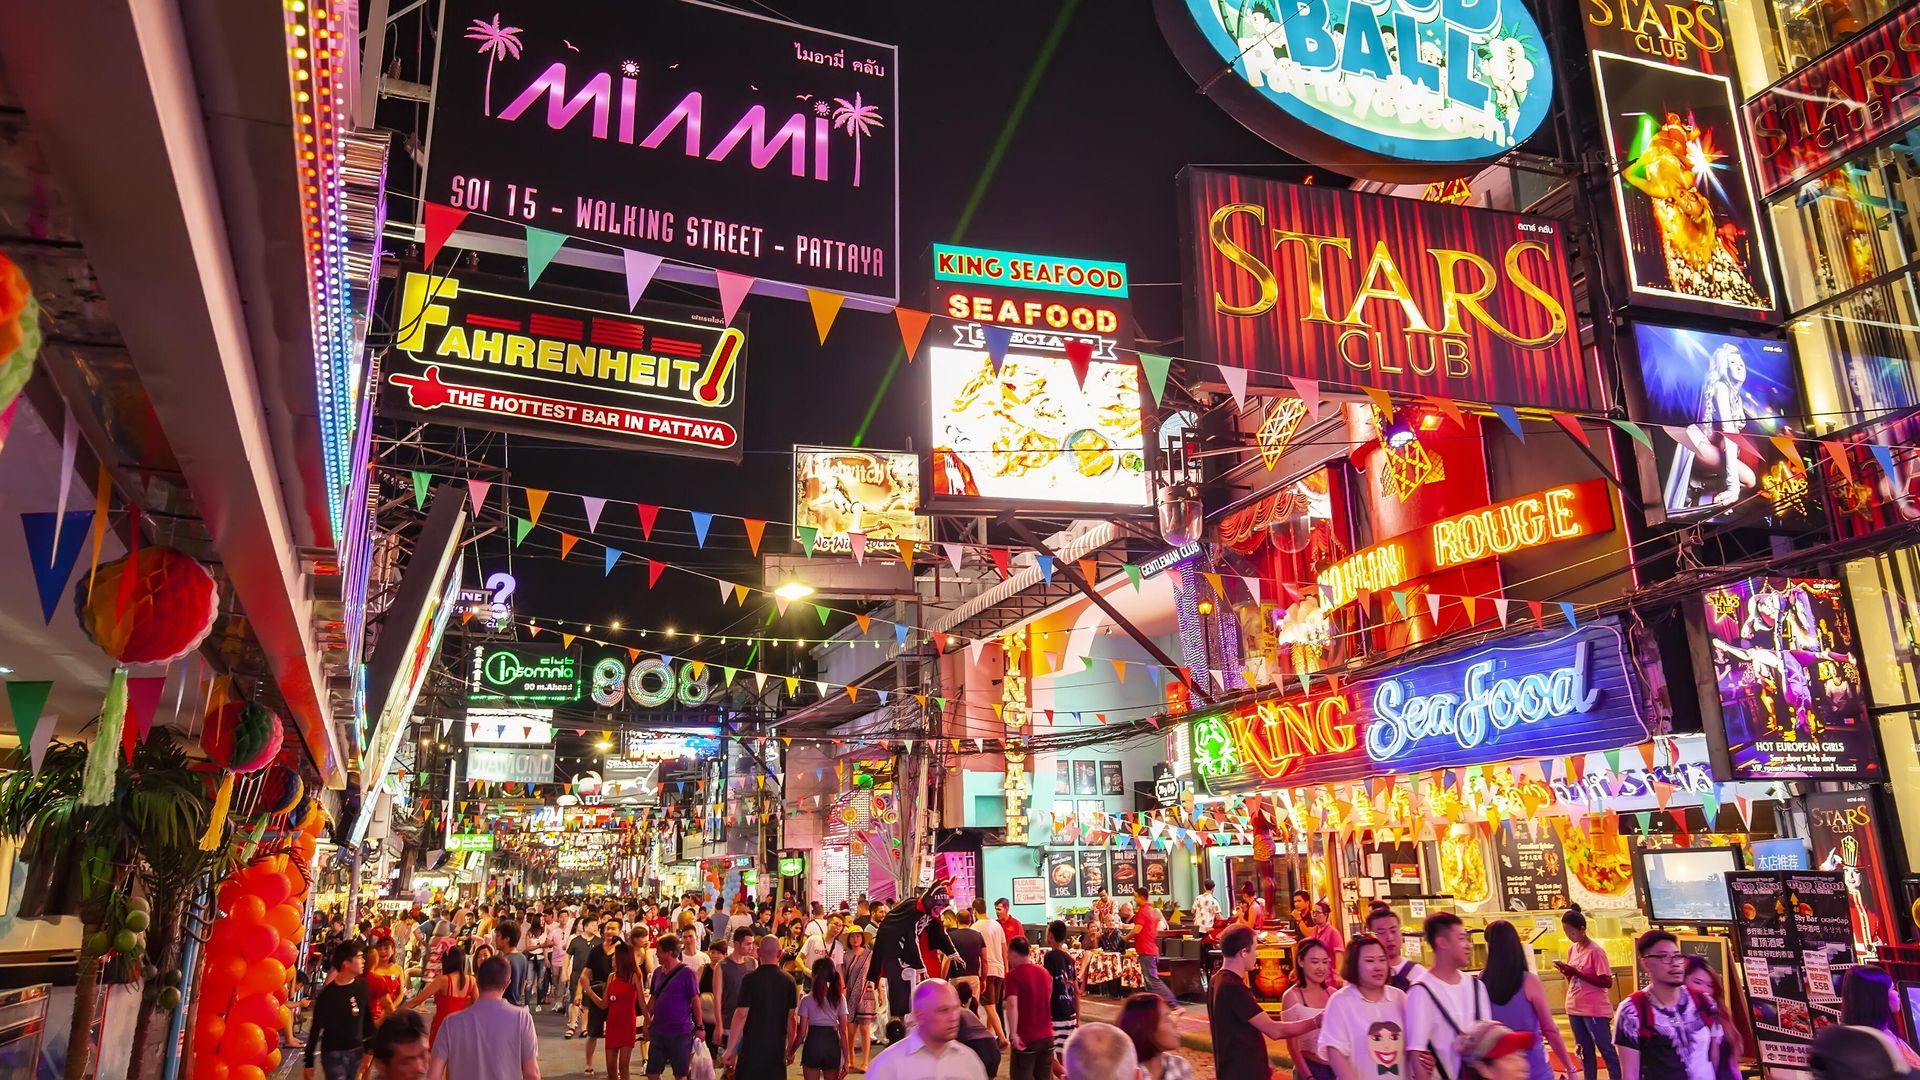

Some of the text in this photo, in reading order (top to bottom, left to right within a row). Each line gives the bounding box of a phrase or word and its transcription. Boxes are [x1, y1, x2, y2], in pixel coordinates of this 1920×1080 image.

[1277, 0, 1492, 111] BALL
[1634, 34, 1688, 61] CLUB
[450, 174, 490, 211] SOI
[507, 183, 538, 220] 15
[576, 196, 675, 244] WALKING
[686, 215, 763, 259] STREET
[796, 234, 885, 278] PATTAYA
[938, 252, 1124, 290] KING SEAFOOD
[1208, 202, 1568, 352] STARS
[397, 271, 701, 391] FAHRENHEIT
[947, 293, 1118, 334] SEAFOOD
[1337, 328, 1473, 380] CLUB
[446, 387, 726, 442] THE HOTTEST BAR IN PATTAYA
[1433, 488, 1582, 568] ROUGE
[1140, 541, 1200, 577] GENTLEMAN CLUB
[540, 656, 574, 665] club
[524, 683, 535, 691] 90
[591, 656, 712, 708] 808
[468, 754, 555, 774] DIAMOND
[1755, 741, 1845, 752] HOT EUROPEAN GIRLS
[1811, 805, 1871, 827] STARS
[1832, 824, 1855, 834] CLUB
[1750, 978, 1769, 987] BEER
[1809, 973, 1829, 981] BEER
[1765, 1043, 1779, 1052] OPEN
